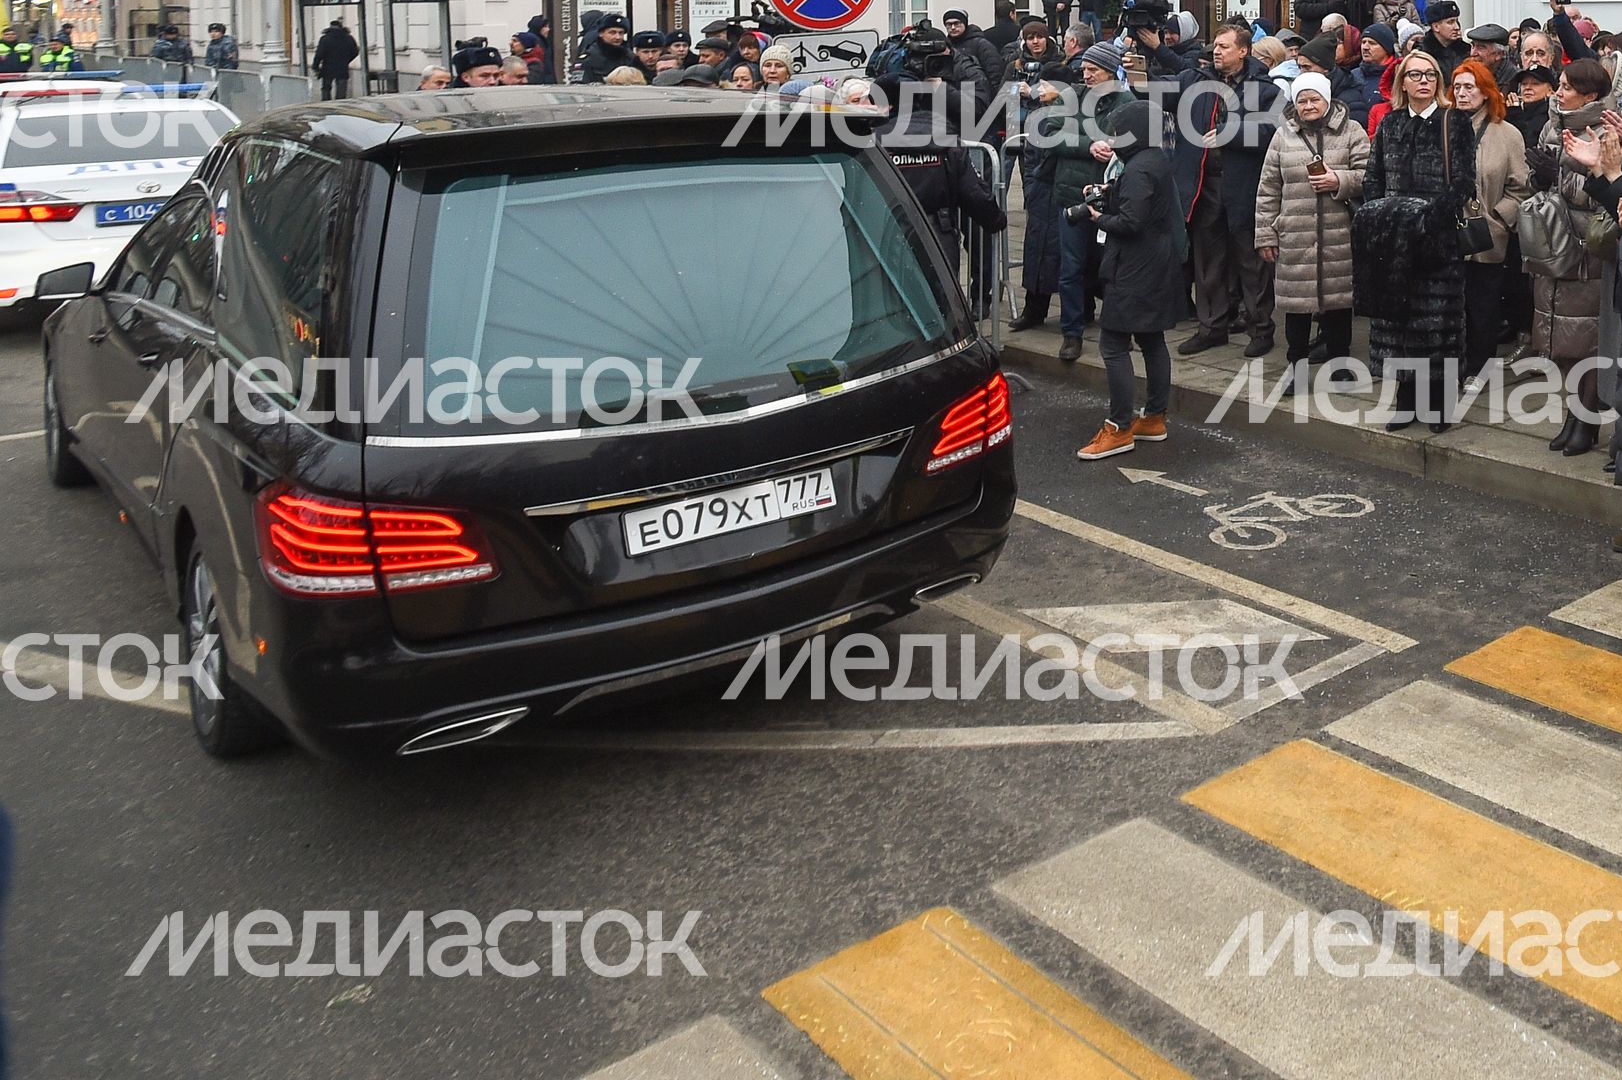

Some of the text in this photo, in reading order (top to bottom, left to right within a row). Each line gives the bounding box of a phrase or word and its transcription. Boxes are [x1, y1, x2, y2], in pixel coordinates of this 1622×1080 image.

[889, 154, 938, 165] ОЛИЦИЯ
[124, 203, 165, 220] 104
[777, 473, 822, 504] 777
[792, 500, 815, 511] RUS
